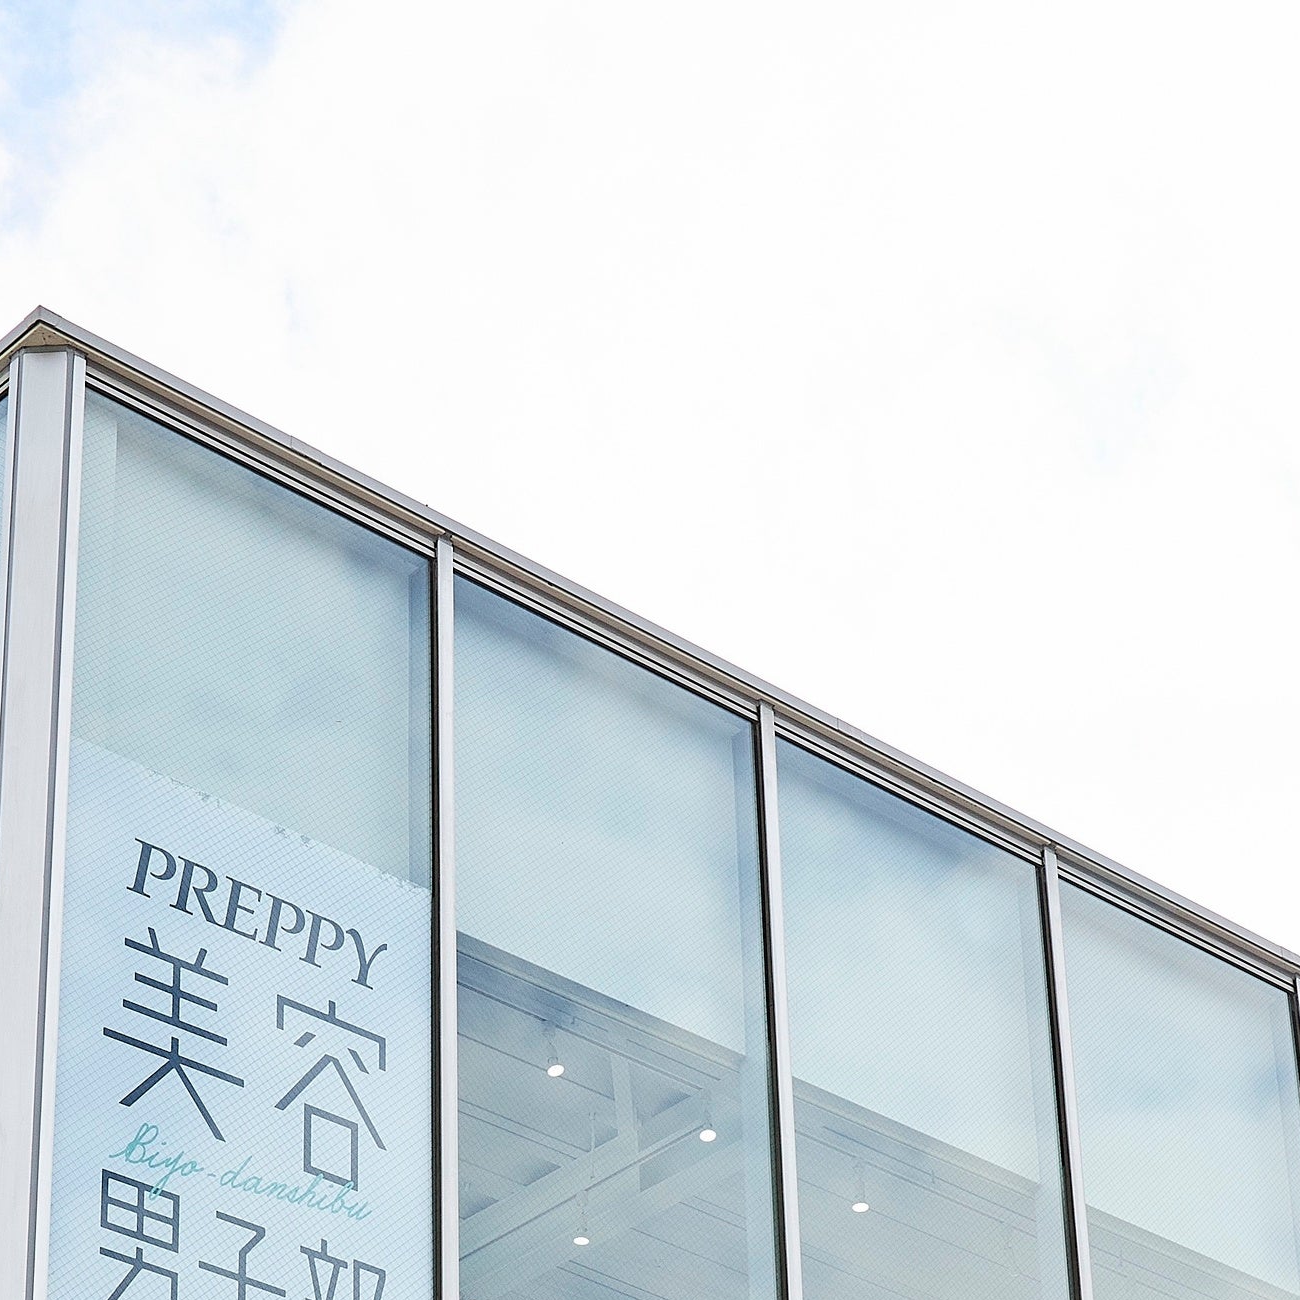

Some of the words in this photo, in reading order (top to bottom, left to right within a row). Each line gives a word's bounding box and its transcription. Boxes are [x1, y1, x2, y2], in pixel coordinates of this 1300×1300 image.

[126, 838, 388, 990] PREPPY
[103, 927, 387, 1191] 美容
[108, 1122, 374, 1222] Biyo-danshibu
